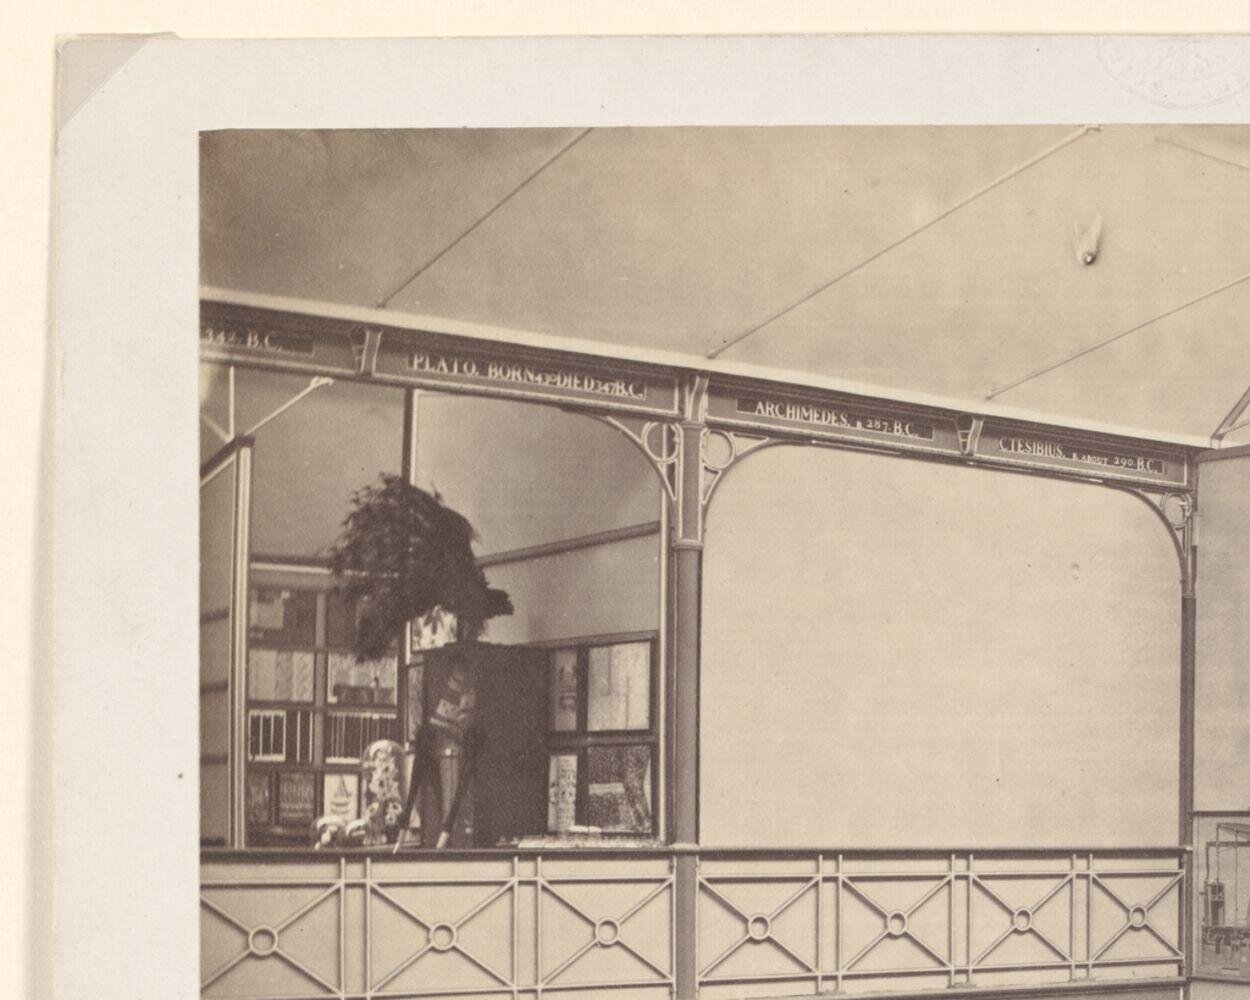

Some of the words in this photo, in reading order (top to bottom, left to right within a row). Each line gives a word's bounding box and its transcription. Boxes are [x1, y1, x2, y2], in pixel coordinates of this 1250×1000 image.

[413, 352, 480, 378] PLATO.
[487, 362, 534, 384] BORN
[755, 401, 851, 428] ARCHIMEDES.
[999, 437, 1067, 458] CTESIBIUS.
